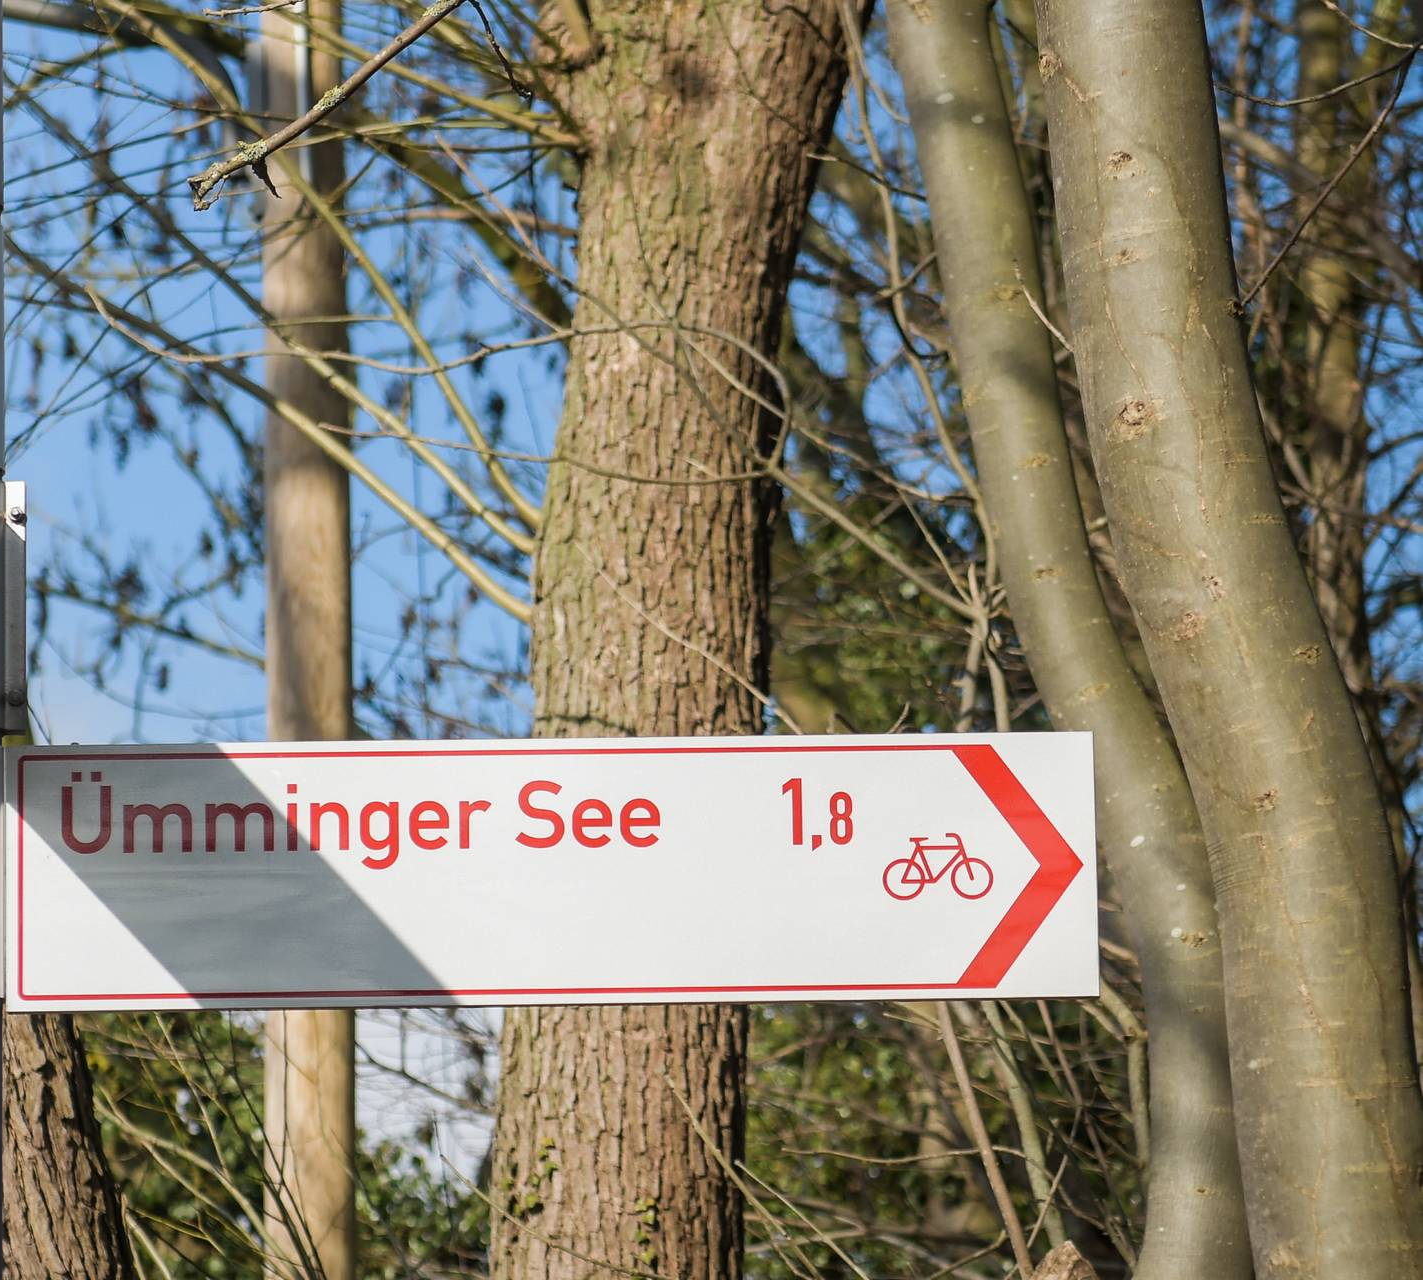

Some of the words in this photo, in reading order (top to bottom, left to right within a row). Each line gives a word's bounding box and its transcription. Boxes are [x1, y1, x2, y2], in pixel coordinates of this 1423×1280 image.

[60, 770, 492, 870] Ümminger
[514, 779, 662, 849] See
[781, 777, 854, 850] 1,8
